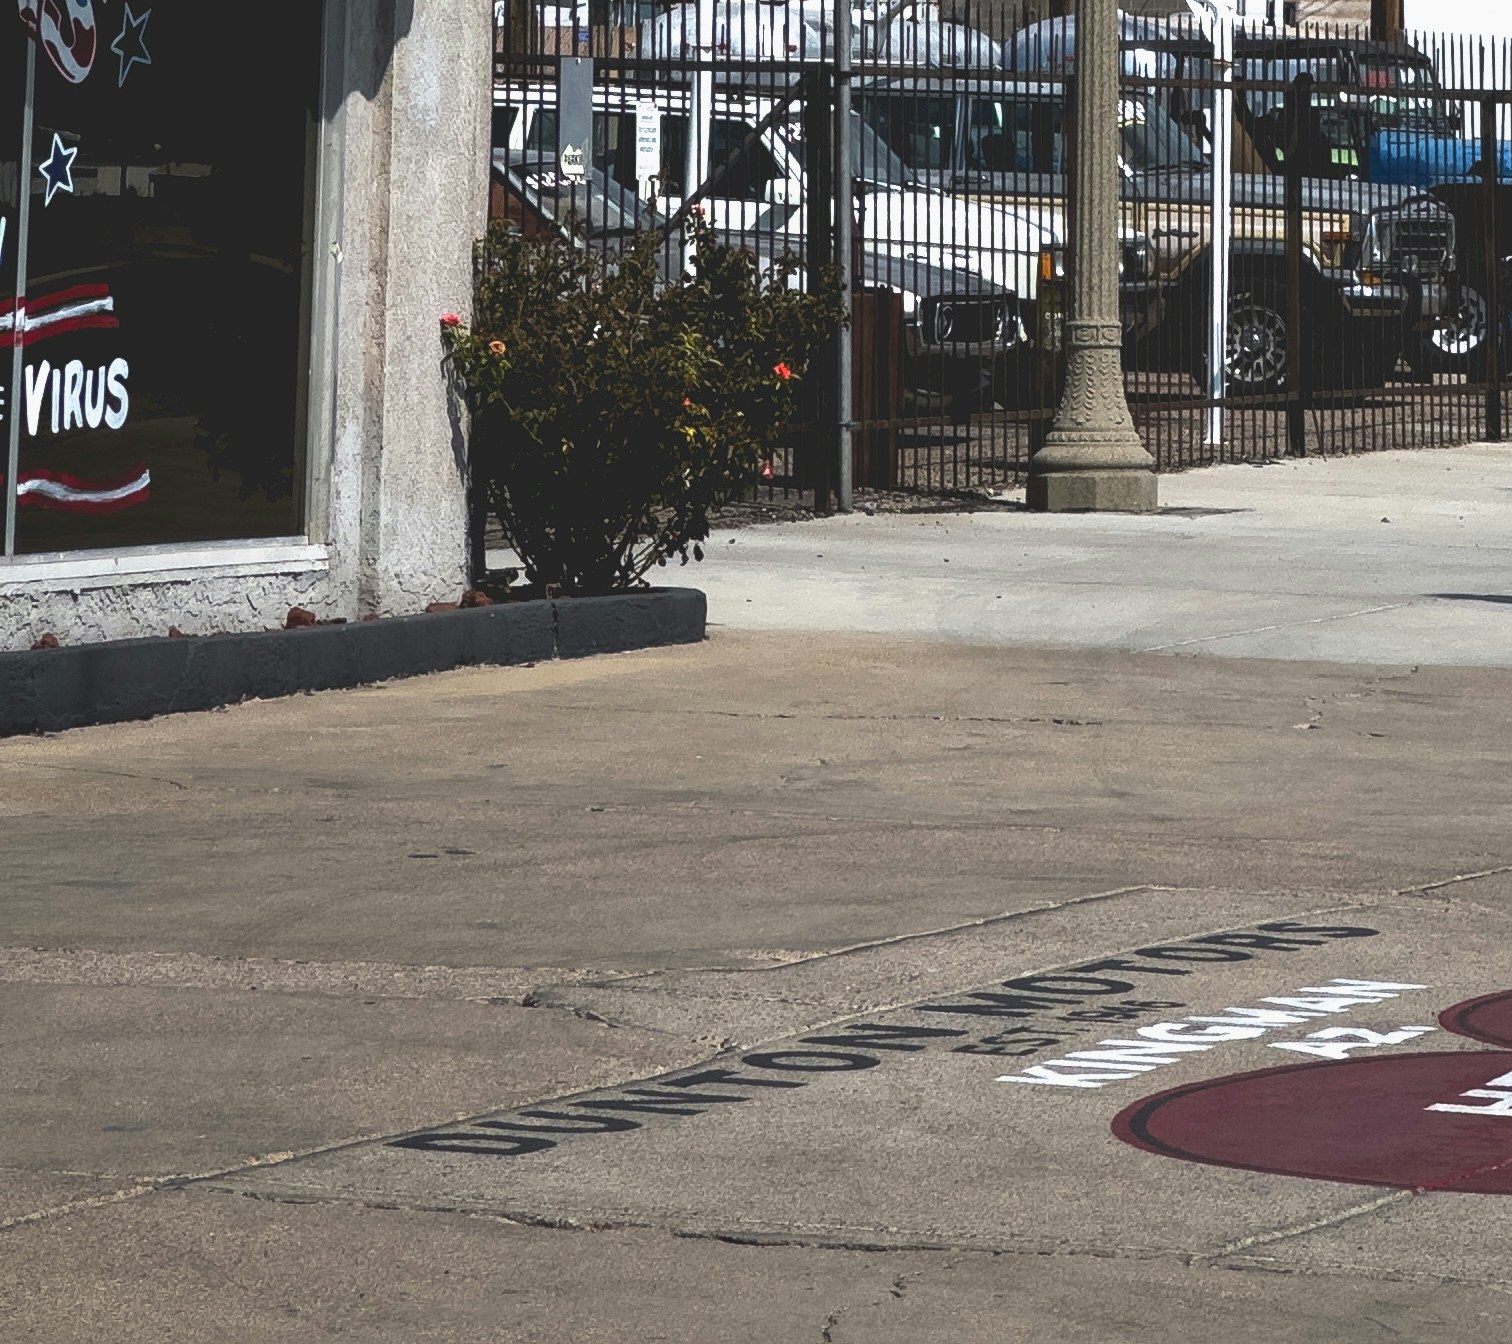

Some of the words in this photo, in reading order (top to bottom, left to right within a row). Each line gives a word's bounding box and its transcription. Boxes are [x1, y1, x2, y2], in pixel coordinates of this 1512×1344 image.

[25, 358, 129, 436] VIRUS
[384, 1022, 966, 1157] DUNTON
[915, 921, 1381, 1020] MOTORS
[997, 977, 1431, 1089] KINGMAN
[1055, 999, 1188, 1024] 1946
